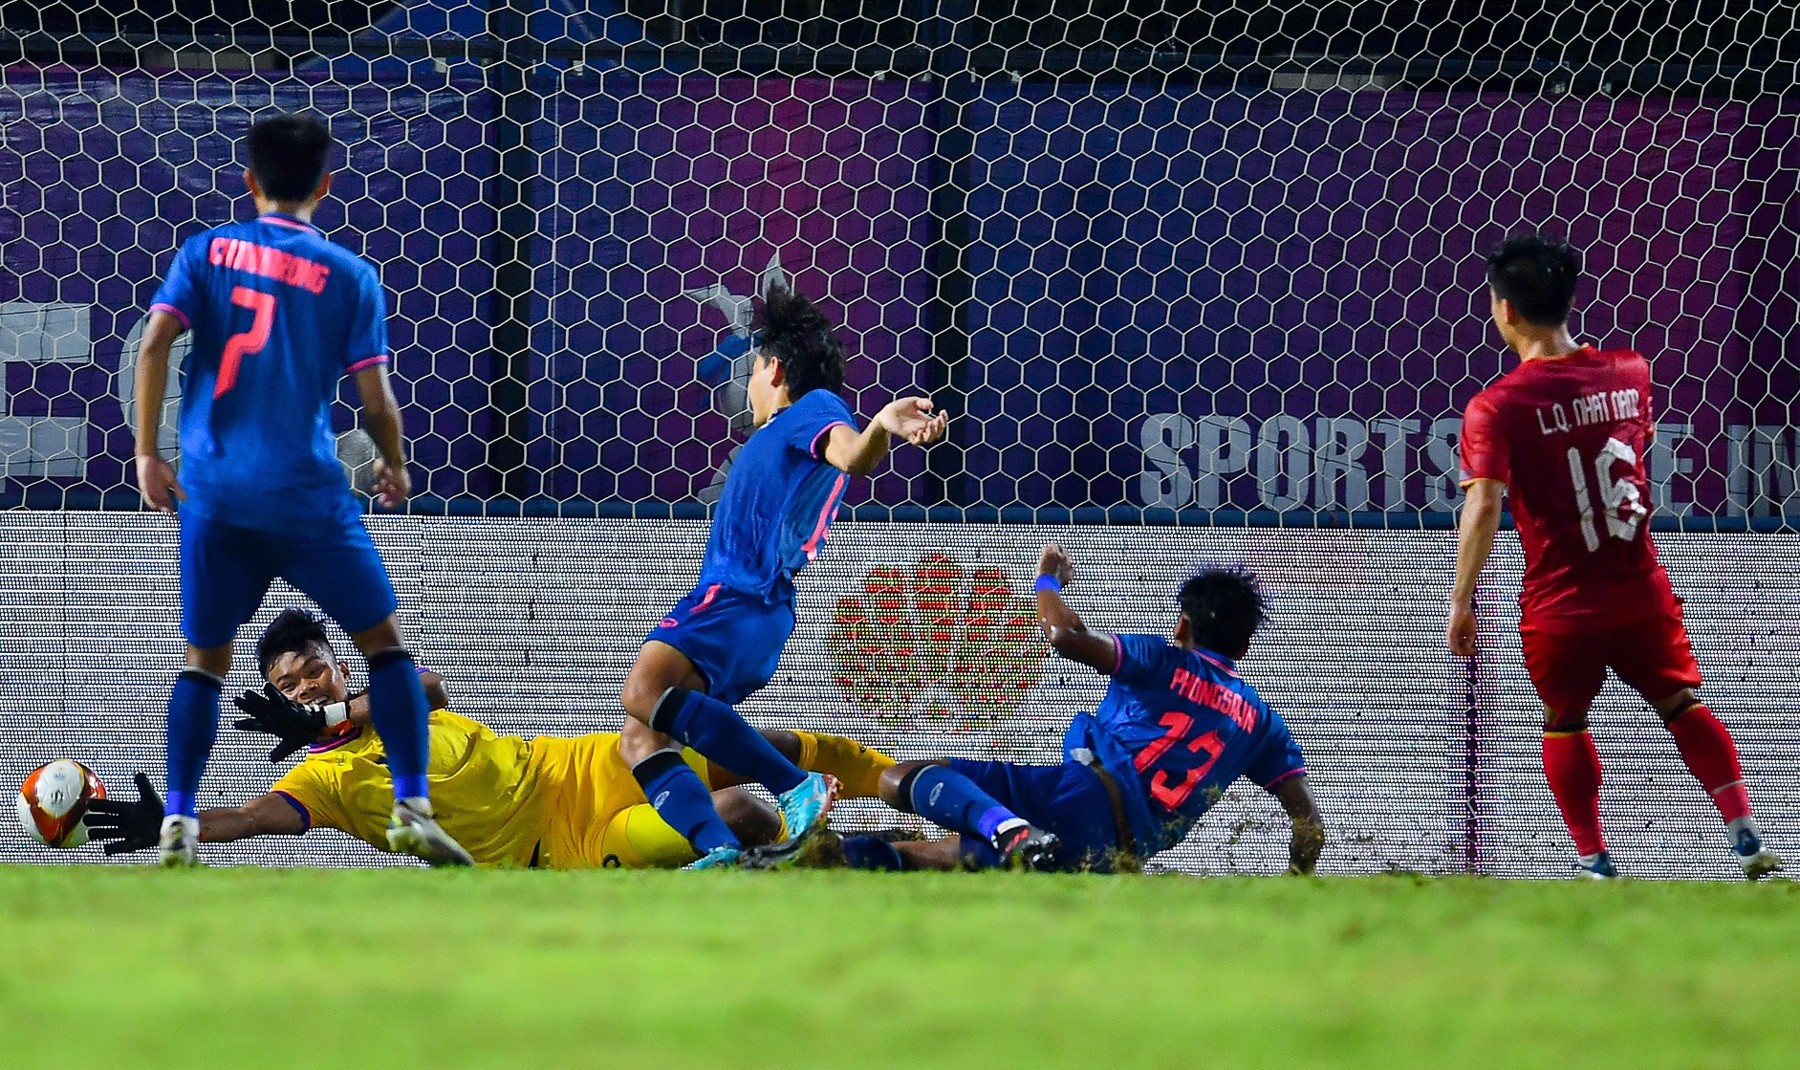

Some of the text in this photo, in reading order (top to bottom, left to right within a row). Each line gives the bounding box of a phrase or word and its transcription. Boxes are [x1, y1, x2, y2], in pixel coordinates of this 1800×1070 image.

[212, 286, 277, 400] 7
[1139, 413, 1466, 514] SPORTS
[1567, 437, 1648, 552] 16
[1133, 711, 1226, 812] 13
